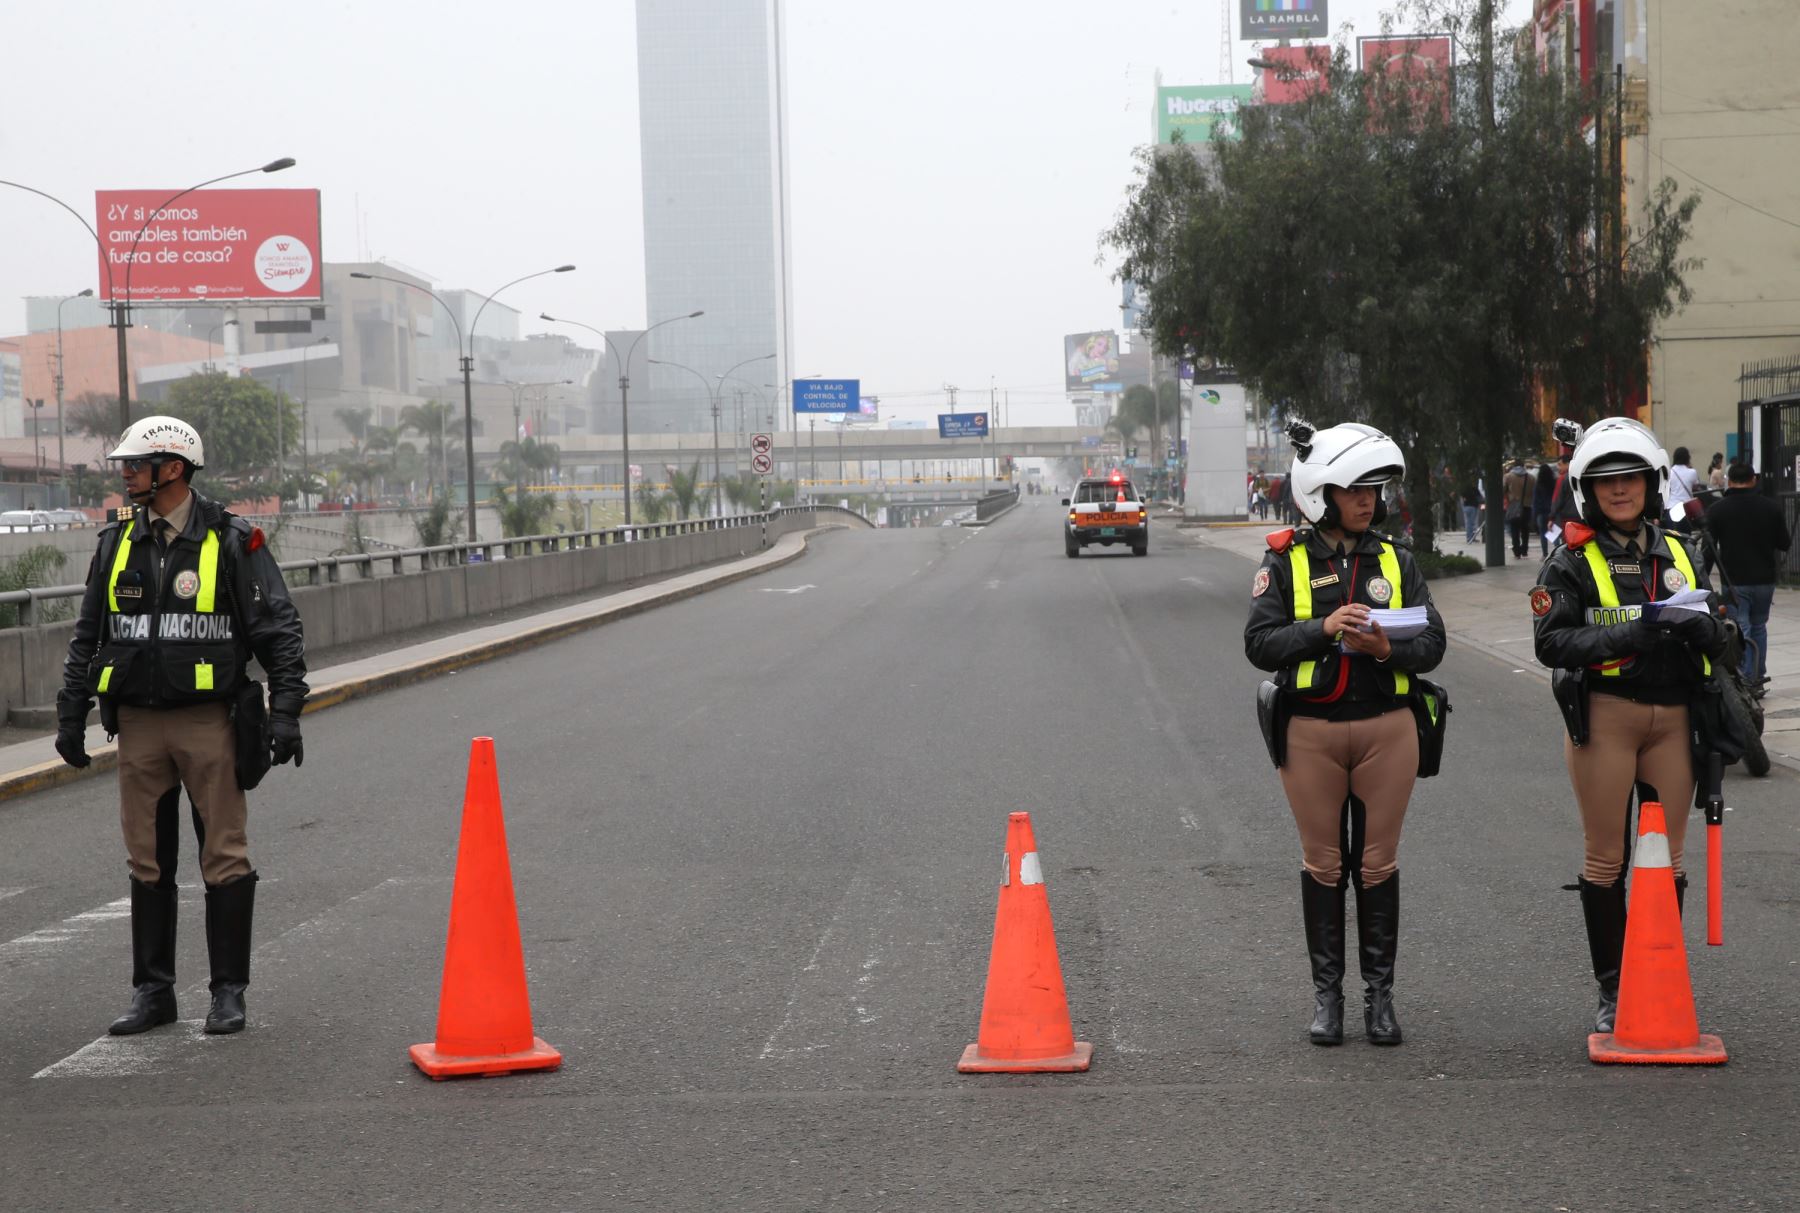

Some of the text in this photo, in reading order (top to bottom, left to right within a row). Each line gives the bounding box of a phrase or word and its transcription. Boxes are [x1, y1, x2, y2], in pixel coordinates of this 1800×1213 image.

[1249, 14, 1320, 24] LA RAMBLA
[108, 204, 198, 221] ¿Y si somos
[109, 224, 247, 242] amables también
[110, 246, 233, 263] fuera de casa?
[264, 268, 306, 280] Siempre
[824, 383, 844, 391] BAJO
[803, 392, 848, 400] CONTROL DE
[142, 425, 195, 445] TRANSITO
[1086, 512, 1128, 521] POLICIA
[159, 613, 232, 639] NACIONAL
